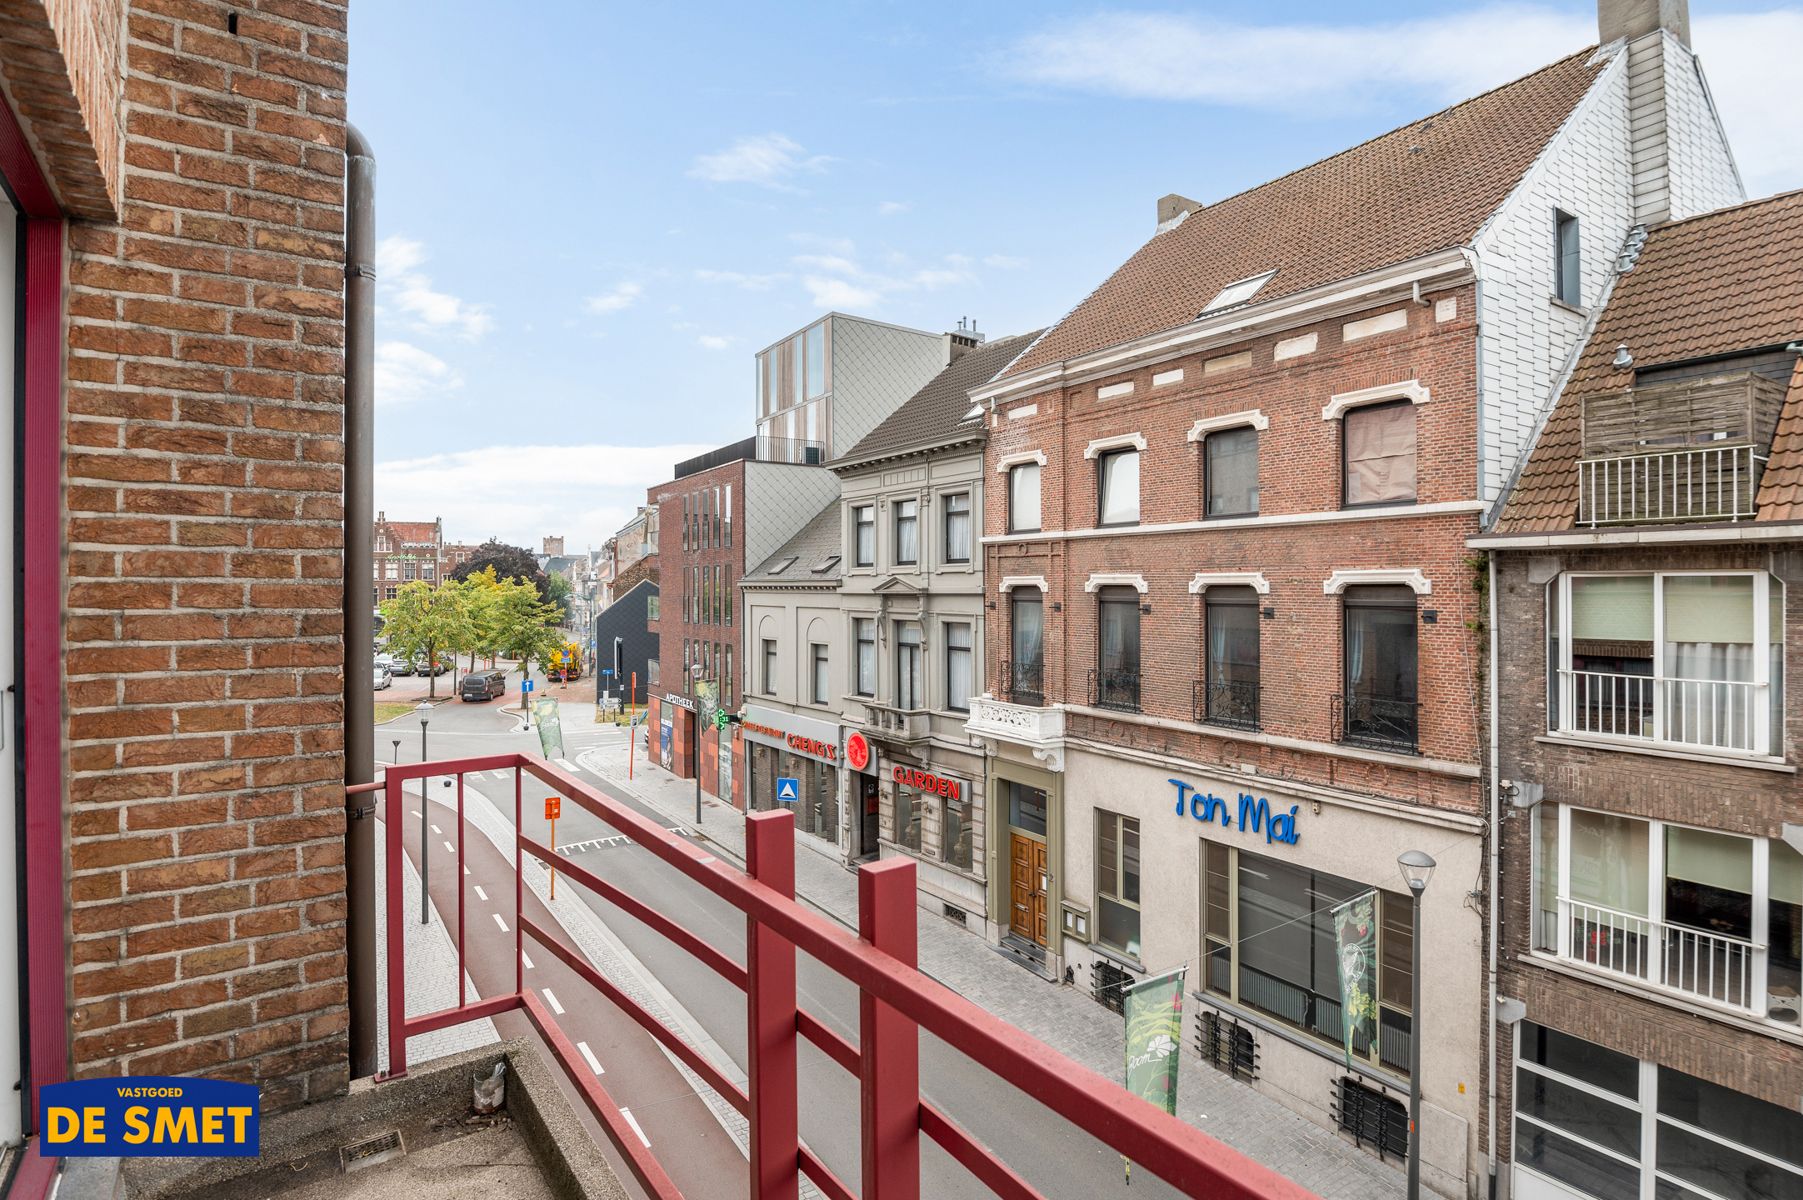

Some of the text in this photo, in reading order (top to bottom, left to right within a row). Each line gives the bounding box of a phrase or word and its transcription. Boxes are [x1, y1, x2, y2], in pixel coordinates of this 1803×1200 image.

[665, 693, 694, 709] APOTHEEK
[893, 766, 960, 800] GARDEN
[1168, 778, 1231, 827] Ton
